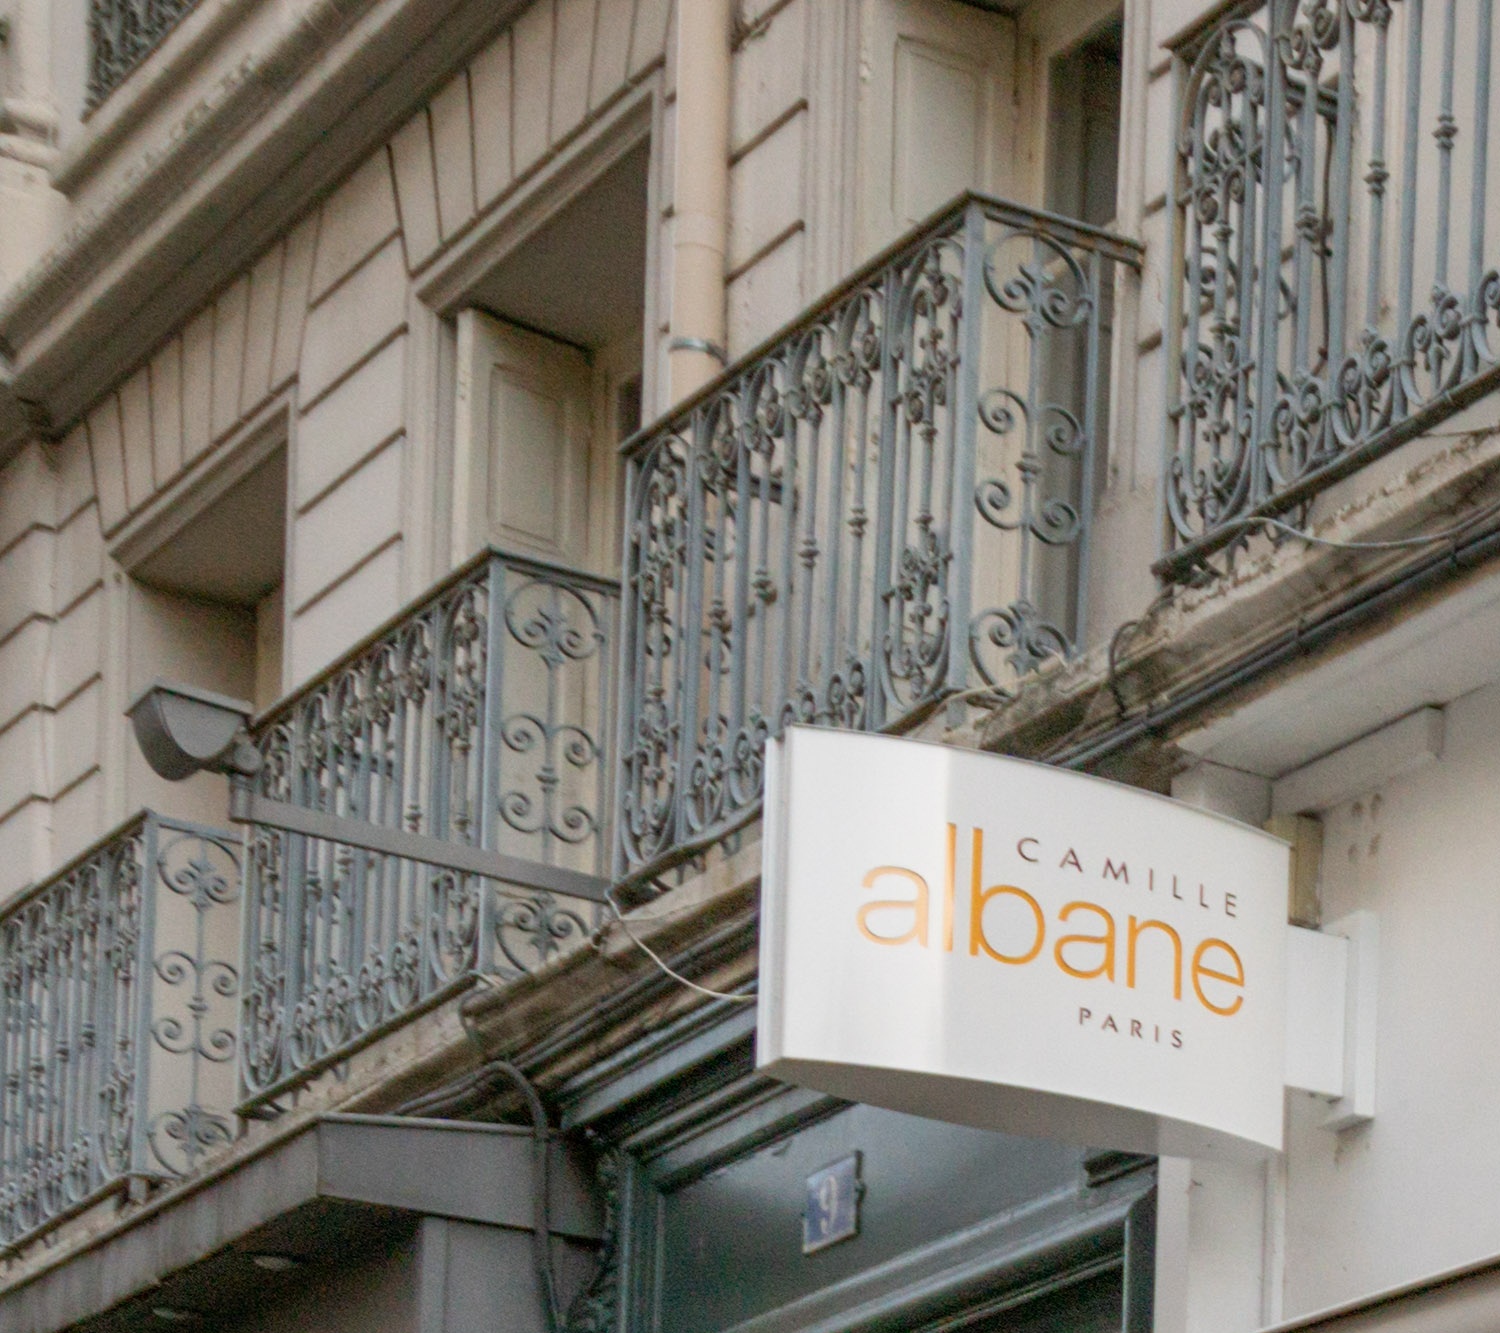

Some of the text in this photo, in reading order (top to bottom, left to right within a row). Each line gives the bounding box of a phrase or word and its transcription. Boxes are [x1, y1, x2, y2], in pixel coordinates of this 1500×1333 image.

[1017, 836, 1238, 918] CAMILLE
[855, 822, 1246, 1017] albane
[1078, 1007, 1185, 1050] PARIS
[818, 1173, 839, 1236] 9
